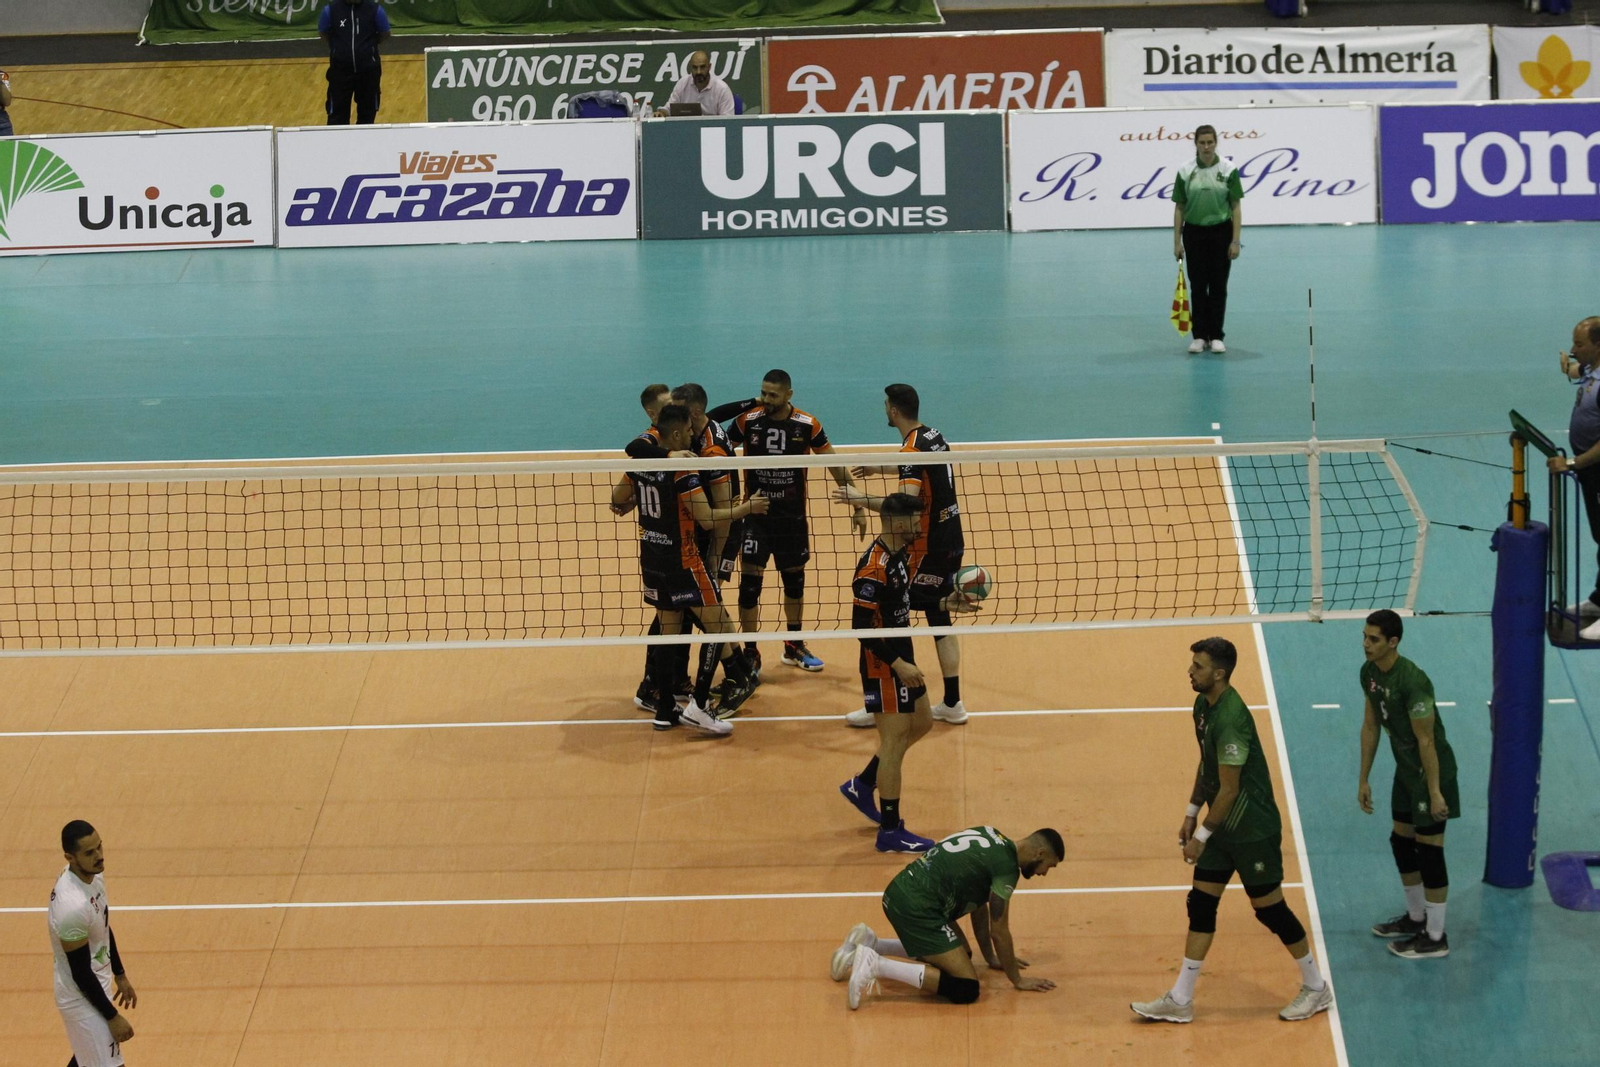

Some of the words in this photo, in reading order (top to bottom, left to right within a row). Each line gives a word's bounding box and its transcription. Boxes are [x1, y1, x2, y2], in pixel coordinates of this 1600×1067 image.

[431, 49, 645, 89] ANÚNCIESE
[1143, 45, 1256, 76] Diario
[1261, 44, 1304, 74] de
[1310, 41, 1457, 74] Almería
[844, 60, 1087, 112] ALMERÍA
[472, 95, 537, 121] 950
[1119, 126, 1267, 142] autocres
[400, 150, 497, 181] Viajes
[700, 122, 947, 199] URCI
[1019, 151, 1102, 202] R.
[1237, 147, 1370, 197] Pino
[78, 184, 252, 239] Unicaja
[701, 206, 949, 230] HORMIGONES
[766, 428, 786, 450] 21
[638, 481, 661, 519] 10
[900, 687, 908, 703] 9
